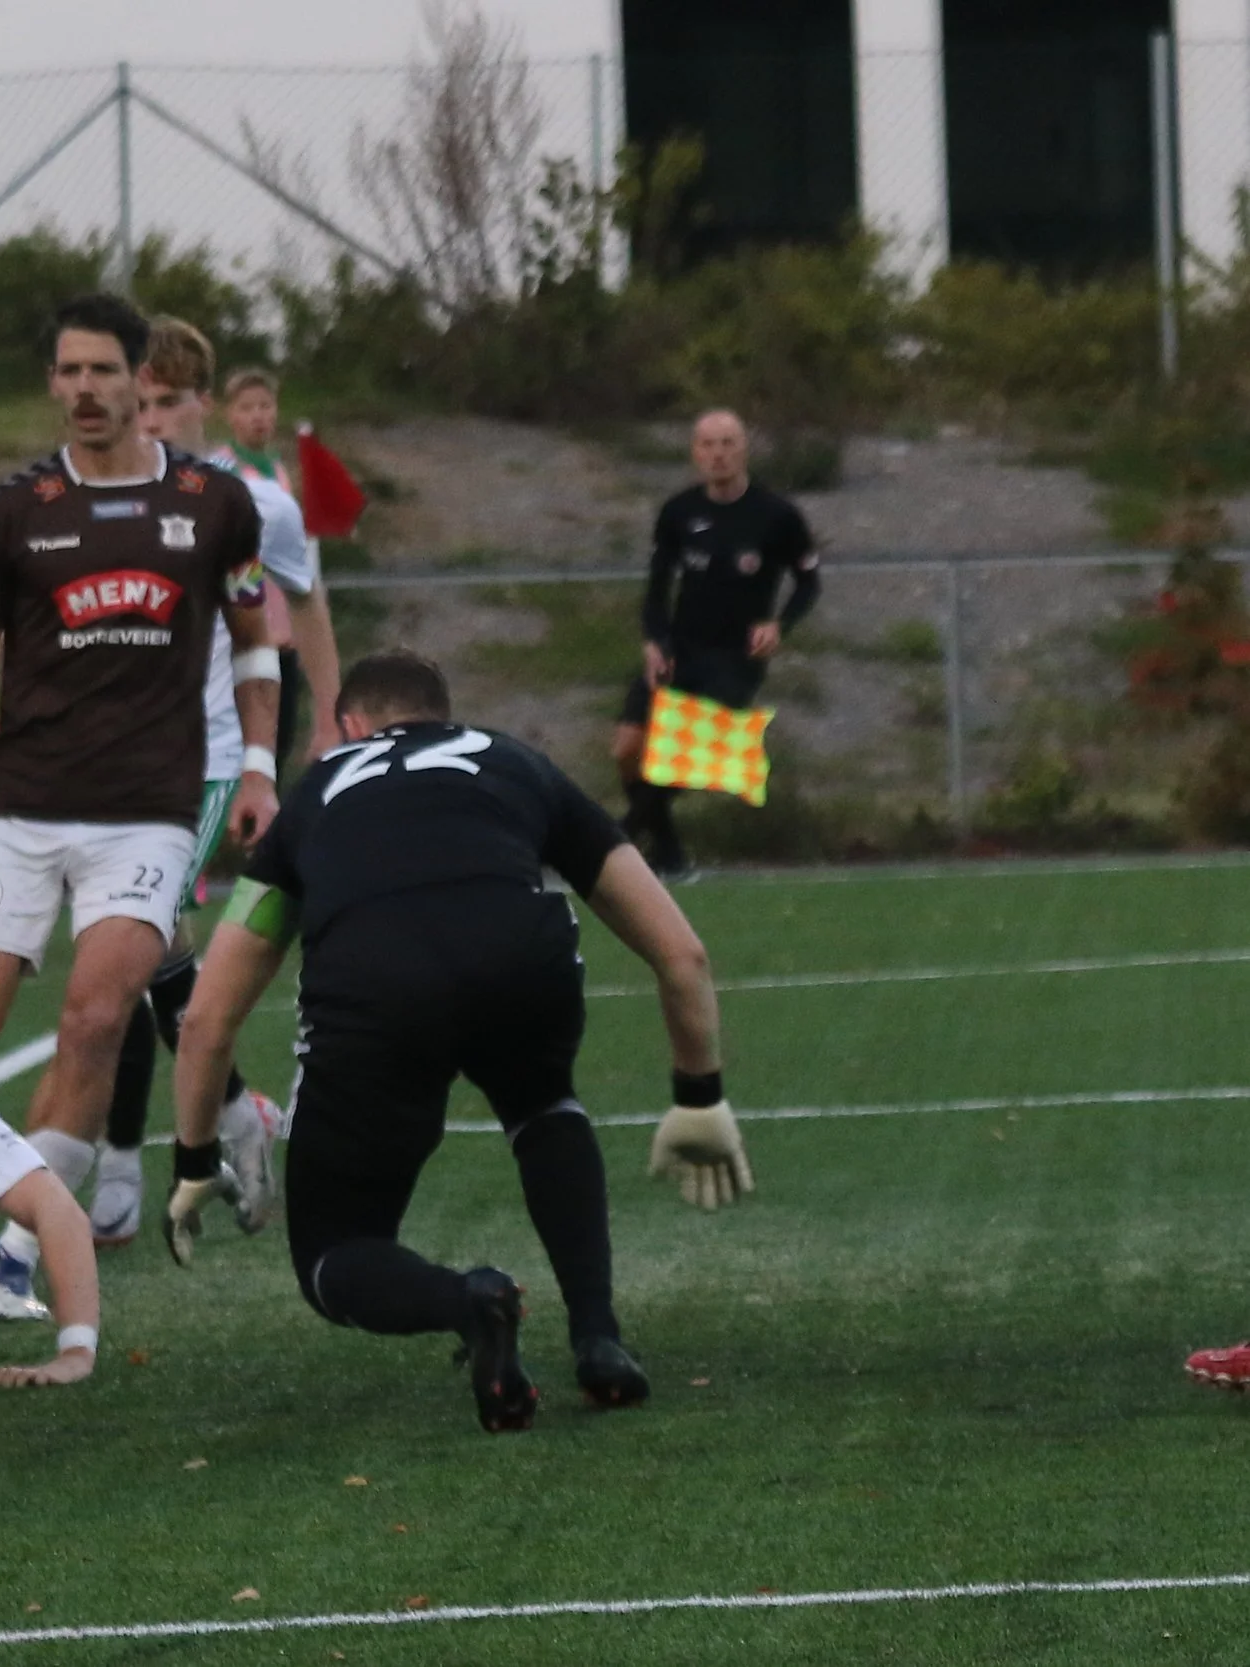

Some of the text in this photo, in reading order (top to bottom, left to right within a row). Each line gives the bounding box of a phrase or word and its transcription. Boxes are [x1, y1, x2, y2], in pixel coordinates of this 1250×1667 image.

[66, 579, 171, 616] MENY
[320, 729, 493, 807] 22
[133, 866, 164, 892] 22
